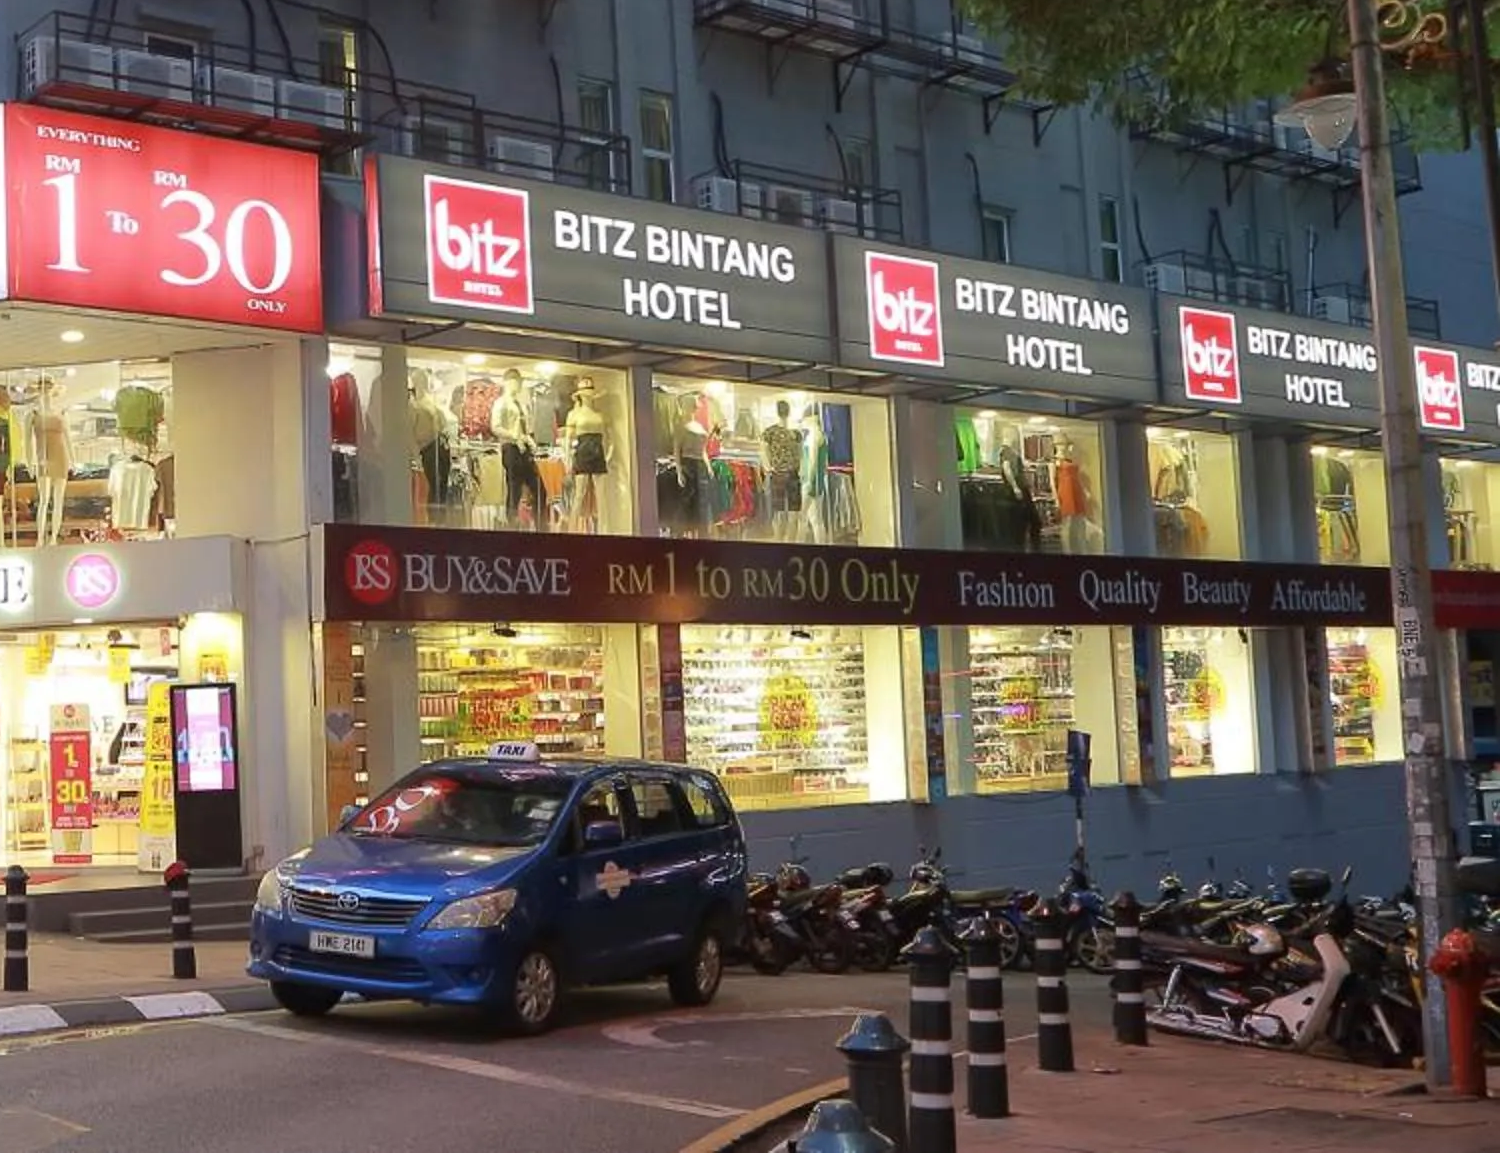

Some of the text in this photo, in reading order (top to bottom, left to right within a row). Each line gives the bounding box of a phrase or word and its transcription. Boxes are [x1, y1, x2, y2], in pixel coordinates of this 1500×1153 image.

[37, 126, 141, 152] EVERYTHING
[45, 154, 188, 189] RM RM
[42, 174, 293, 295] 1 To 30
[435, 198, 521, 278] bitz
[553, 209, 795, 283] BITZ BINTANG
[248, 299, 289, 313] ONLY
[623, 278, 741, 330] HOTEL
[873, 270, 934, 336] bitz
[955, 278, 1129, 335] BITZ BINTANG
[1007, 333, 1092, 375] HOTEL
[1185, 323, 1232, 378] bitz
[1248, 326, 1377, 372] BITZ BINTANG
[1285, 374, 1350, 408] HOTEL
[1466, 362, 1500, 390] BITZ
[404, 554, 571, 595] BUY&SAVE
[696, 559, 731, 599] to
[841, 558, 920, 614] Only
[957, 570, 1054, 609] Fashion
[1079, 570, 1161, 614] Quality
[1183, 572, 1252, 610] Beauty
[1271, 577, 1367, 613] Affordable
[497, 745, 526, 755] TAXI
